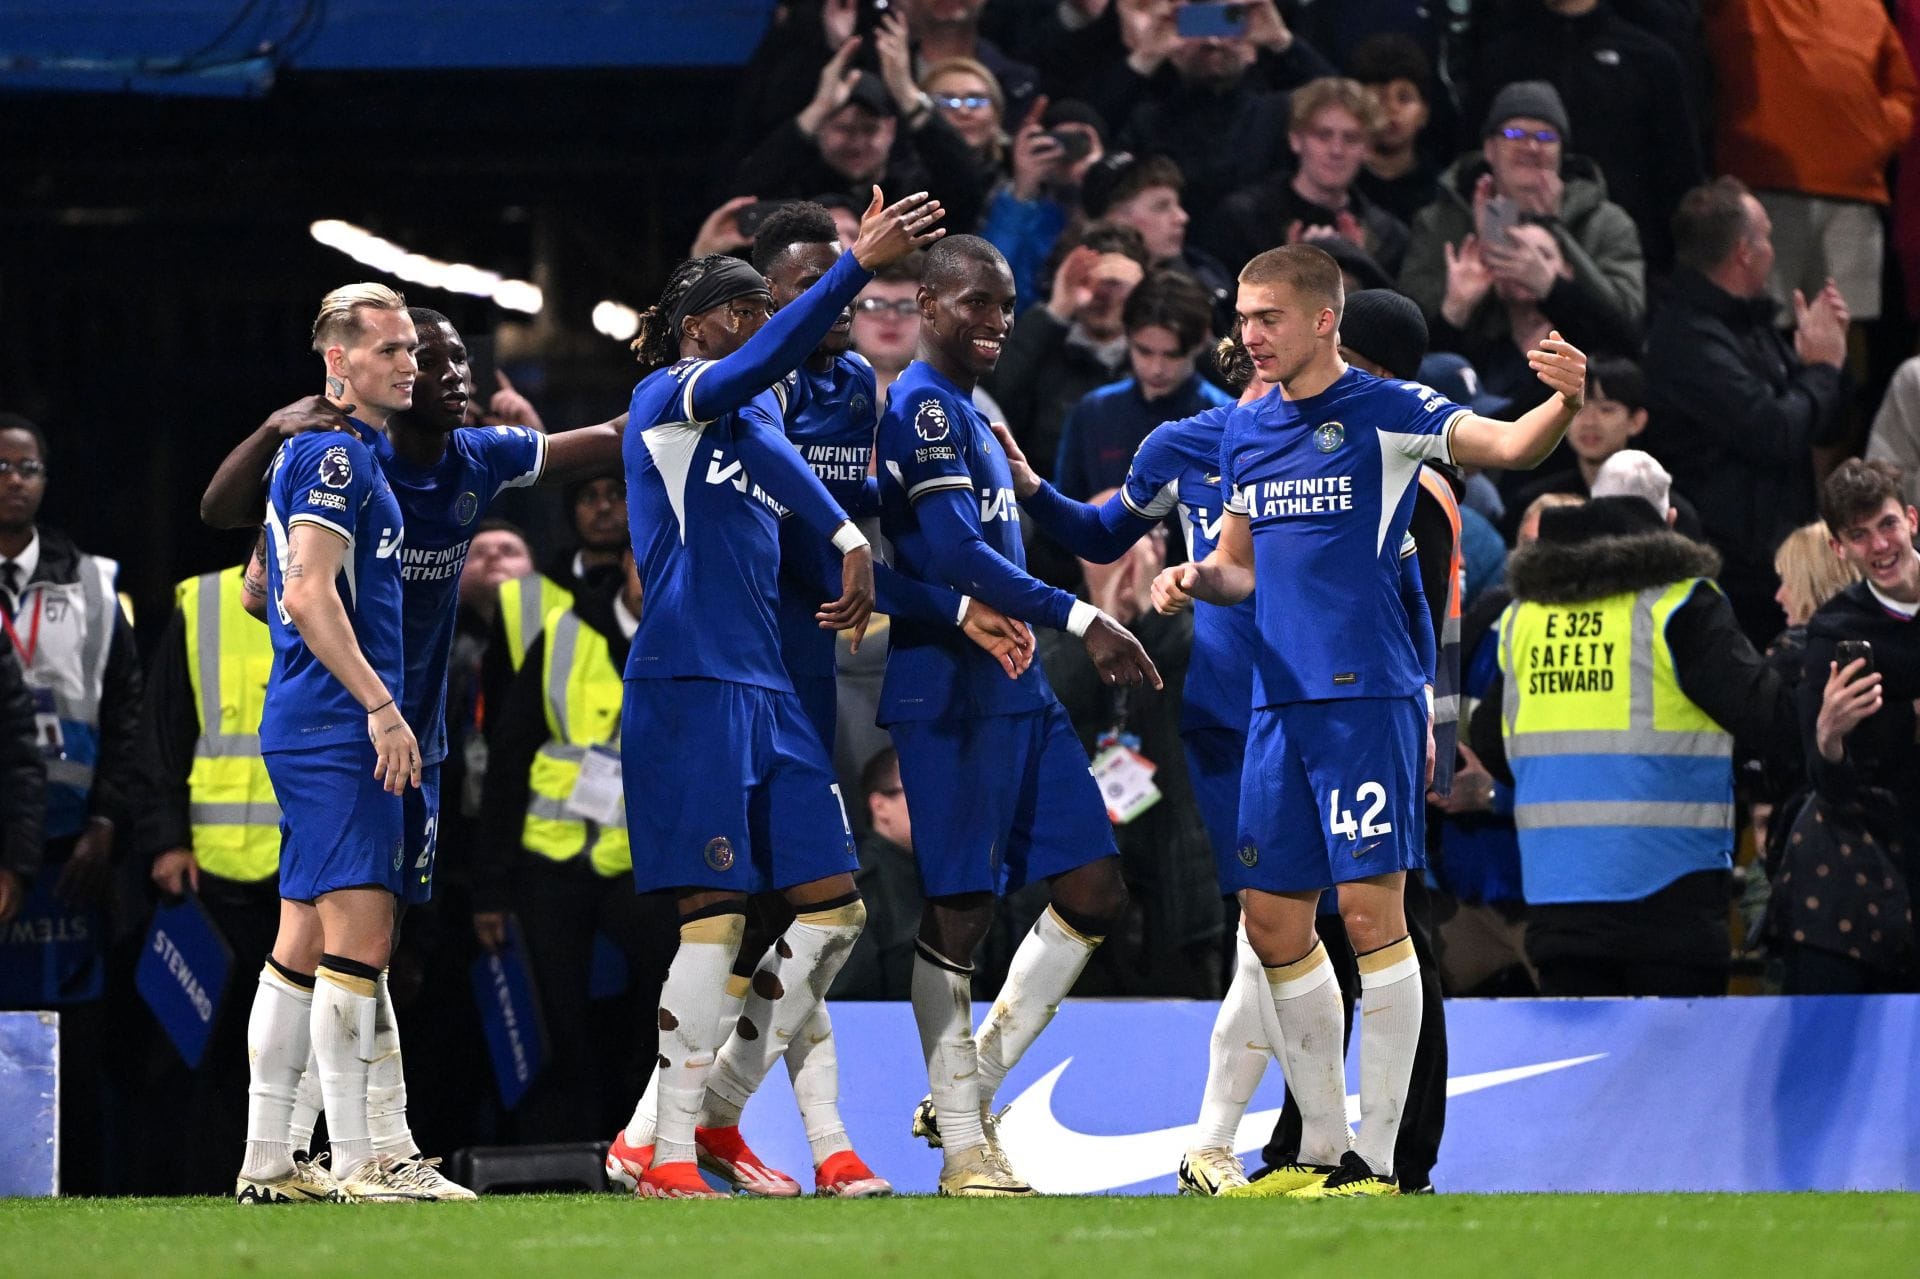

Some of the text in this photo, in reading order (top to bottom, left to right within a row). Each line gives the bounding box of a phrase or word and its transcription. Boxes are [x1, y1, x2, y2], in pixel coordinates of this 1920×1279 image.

[807, 445, 872, 463] INFINITE
[915, 448, 928, 456] No
[310, 489, 346, 504] No room
[1263, 476, 1352, 498] INFINITE
[1263, 494, 1353, 516] ATHLETE
[402, 539, 469, 565] INFINITE
[1546, 611, 1603, 638] E 325
[1530, 642, 1614, 669] SAFETY
[1529, 669, 1614, 695] STEWARD
[1330, 781, 1392, 841] 42
[153, 929, 212, 1023] STEWARD
